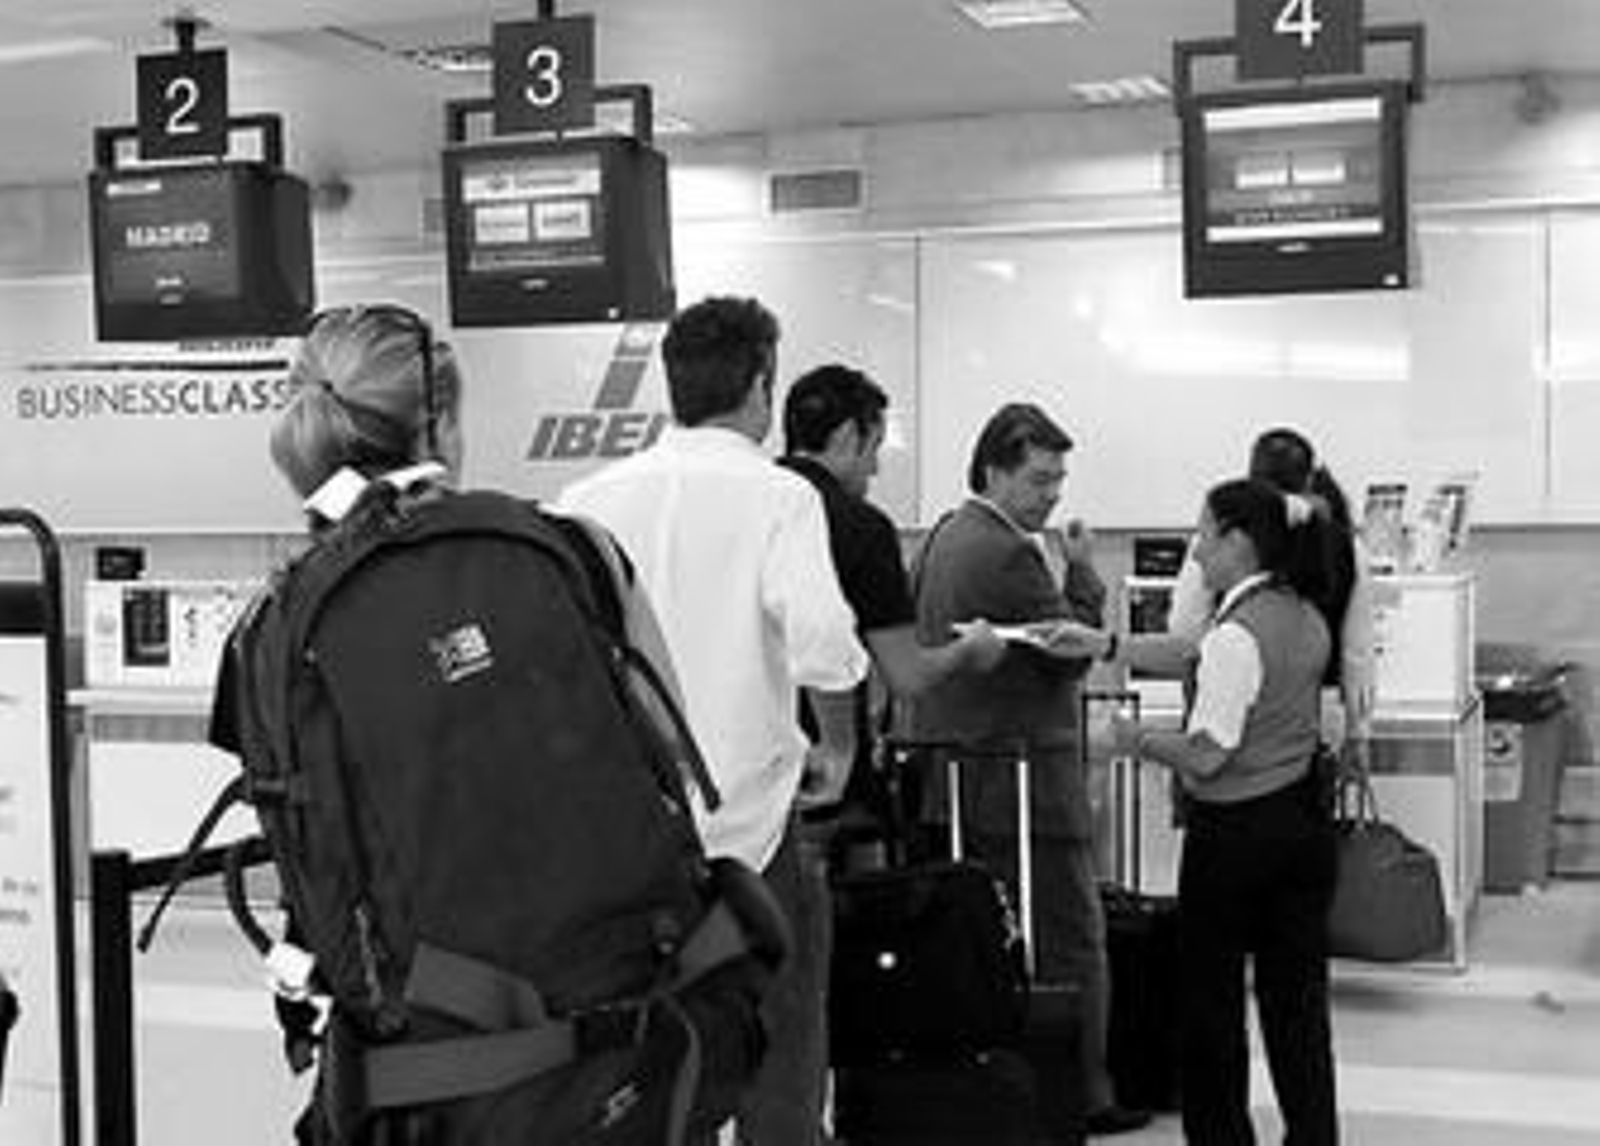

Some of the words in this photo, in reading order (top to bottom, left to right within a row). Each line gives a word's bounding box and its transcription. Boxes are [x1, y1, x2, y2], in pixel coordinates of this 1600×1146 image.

[1273, 0, 1322, 47] 4
[526, 46, 562, 107] 3
[165, 78, 200, 134] 2
